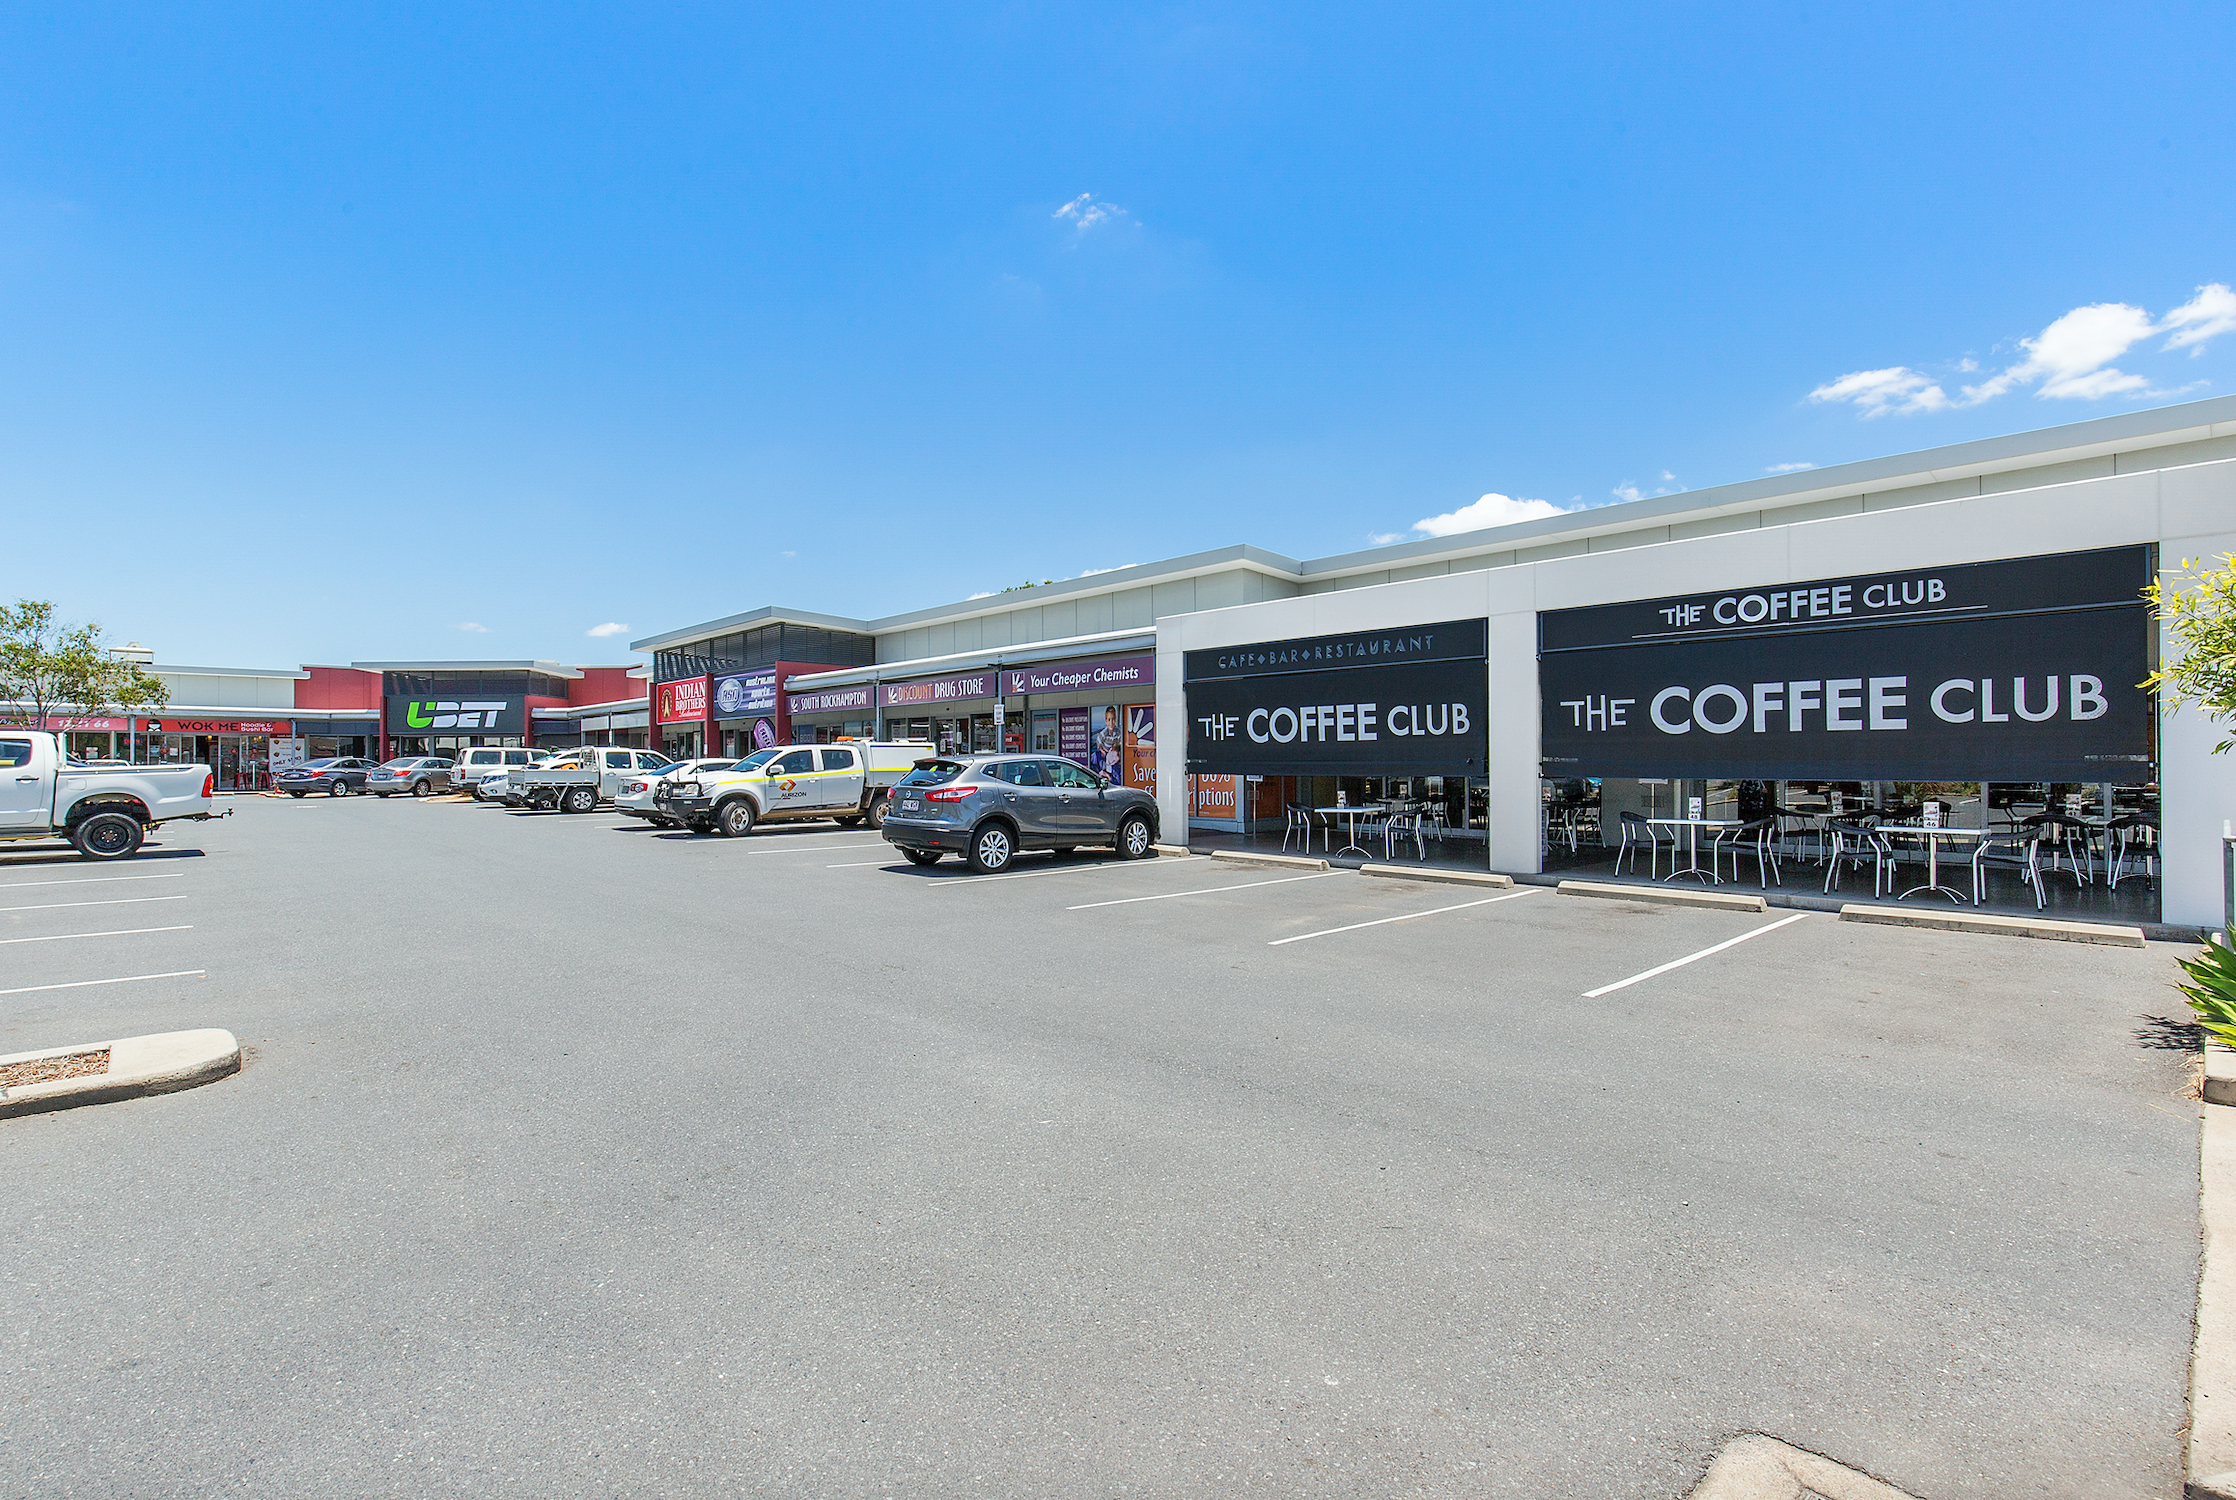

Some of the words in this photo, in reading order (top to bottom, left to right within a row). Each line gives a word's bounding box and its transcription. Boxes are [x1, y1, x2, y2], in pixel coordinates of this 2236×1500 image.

[1659, 603, 1706, 626] THE
[1713, 585, 1852, 624] COFFEE
[1862, 578, 1947, 608] CLUB
[1218, 653, 1255, 669] CAFE
[1269, 649, 1299, 665] BAR
[1314, 635, 1434, 661] RESTAURANT
[1030, 674, 1050, 688] Your
[1051, 672, 1091, 688] Cheaper
[1093, 666, 1139, 682] Chemists
[675, 681, 707, 700] INDIAN
[898, 684, 932, 701] DISCOUNT
[934, 680, 956, 699] DRUG
[958, 677, 984, 697] STORE
[675, 697, 707, 711] BROTHERS
[800, 696, 820, 710] SOUTH
[821, 691, 867, 708] ROCKHAMPTON
[1560, 693, 1636, 732] THE
[1649, 675, 1908, 735] COFFEE
[1930, 674, 2110, 723] CLUB
[93, 719, 110, 728] 66
[406, 701, 508, 728] UBET
[1198, 713, 1240, 741] THE
[1246, 703, 1378, 744] COFFEE
[1387, 703, 1471, 737] CLUB
[177, 721, 214, 731] WOK
[218, 722, 239, 731] ME
[1133, 749, 1148, 757] Your
